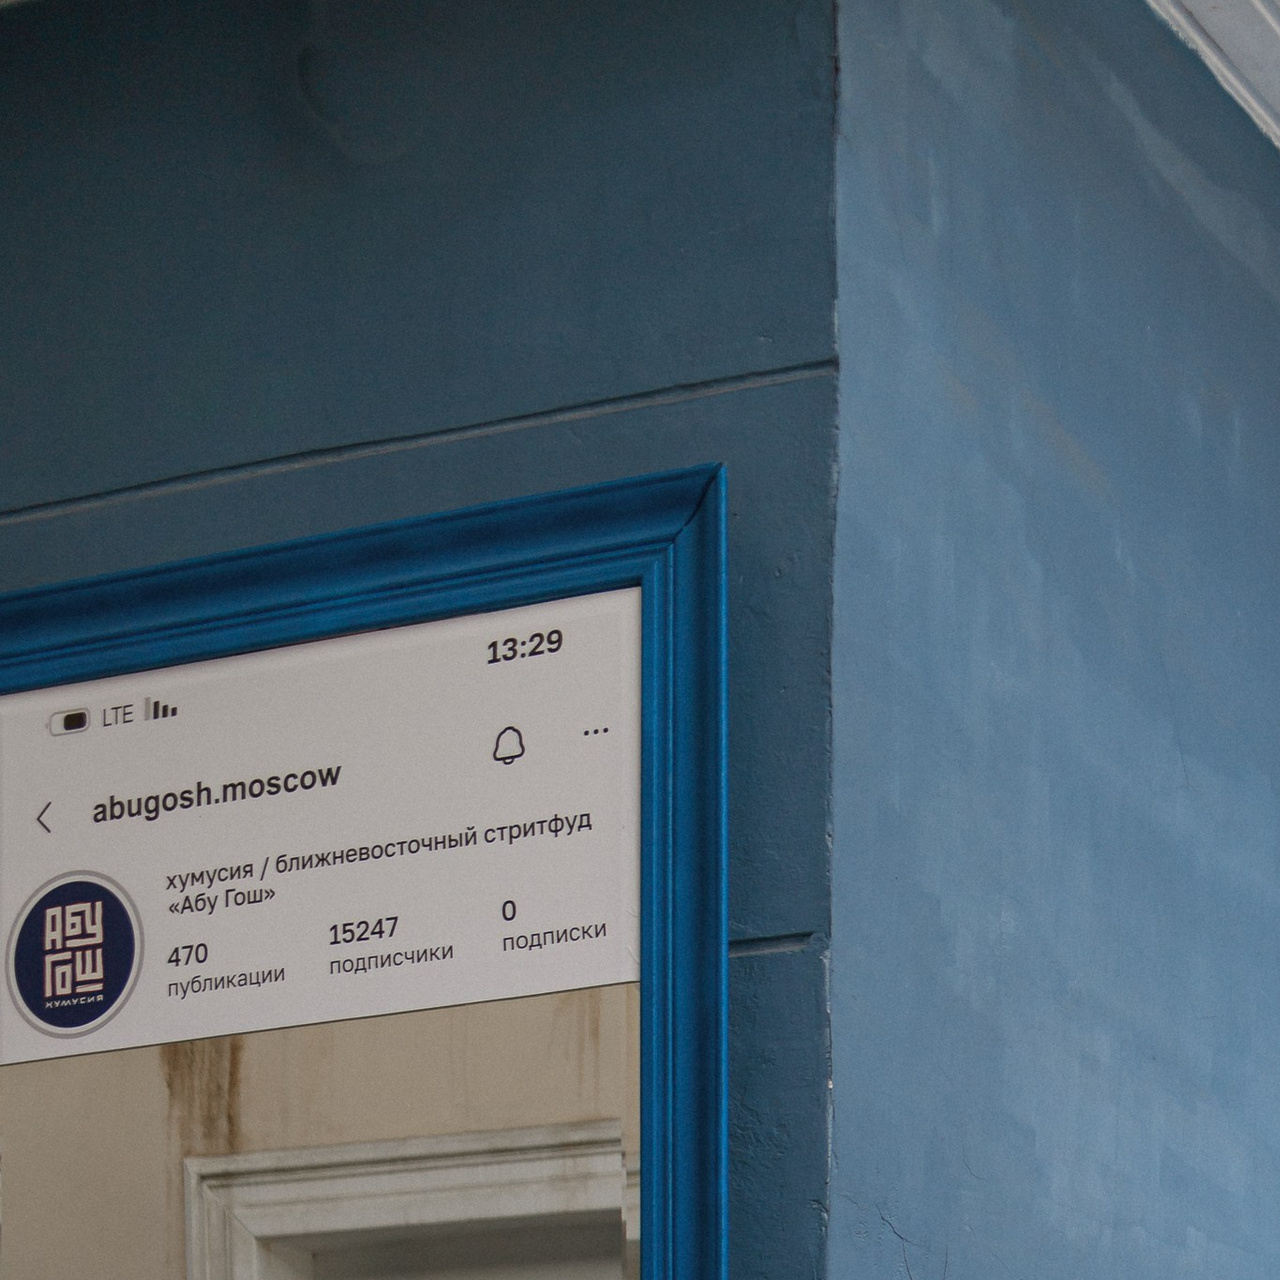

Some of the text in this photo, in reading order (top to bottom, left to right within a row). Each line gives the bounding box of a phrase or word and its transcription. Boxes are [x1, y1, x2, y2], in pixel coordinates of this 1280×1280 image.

[487, 629, 564, 665] 13:29
[102, 703, 134, 727] LTE
[92, 765, 342, 824] abugosh.moscow
[165, 862, 254, 894] хумусия
[274, 825, 478, 874] ближневосточный
[483, 812, 593, 845] стритфуд
[168, 887, 276, 915] «Абу Гош»
[501, 899, 517, 922] 0
[329, 915, 399, 946] 15247
[502, 922, 607, 952] подписки
[166, 942, 209, 968] 470
[329, 944, 454, 976] подписчики
[168, 967, 286, 1000] публикации
